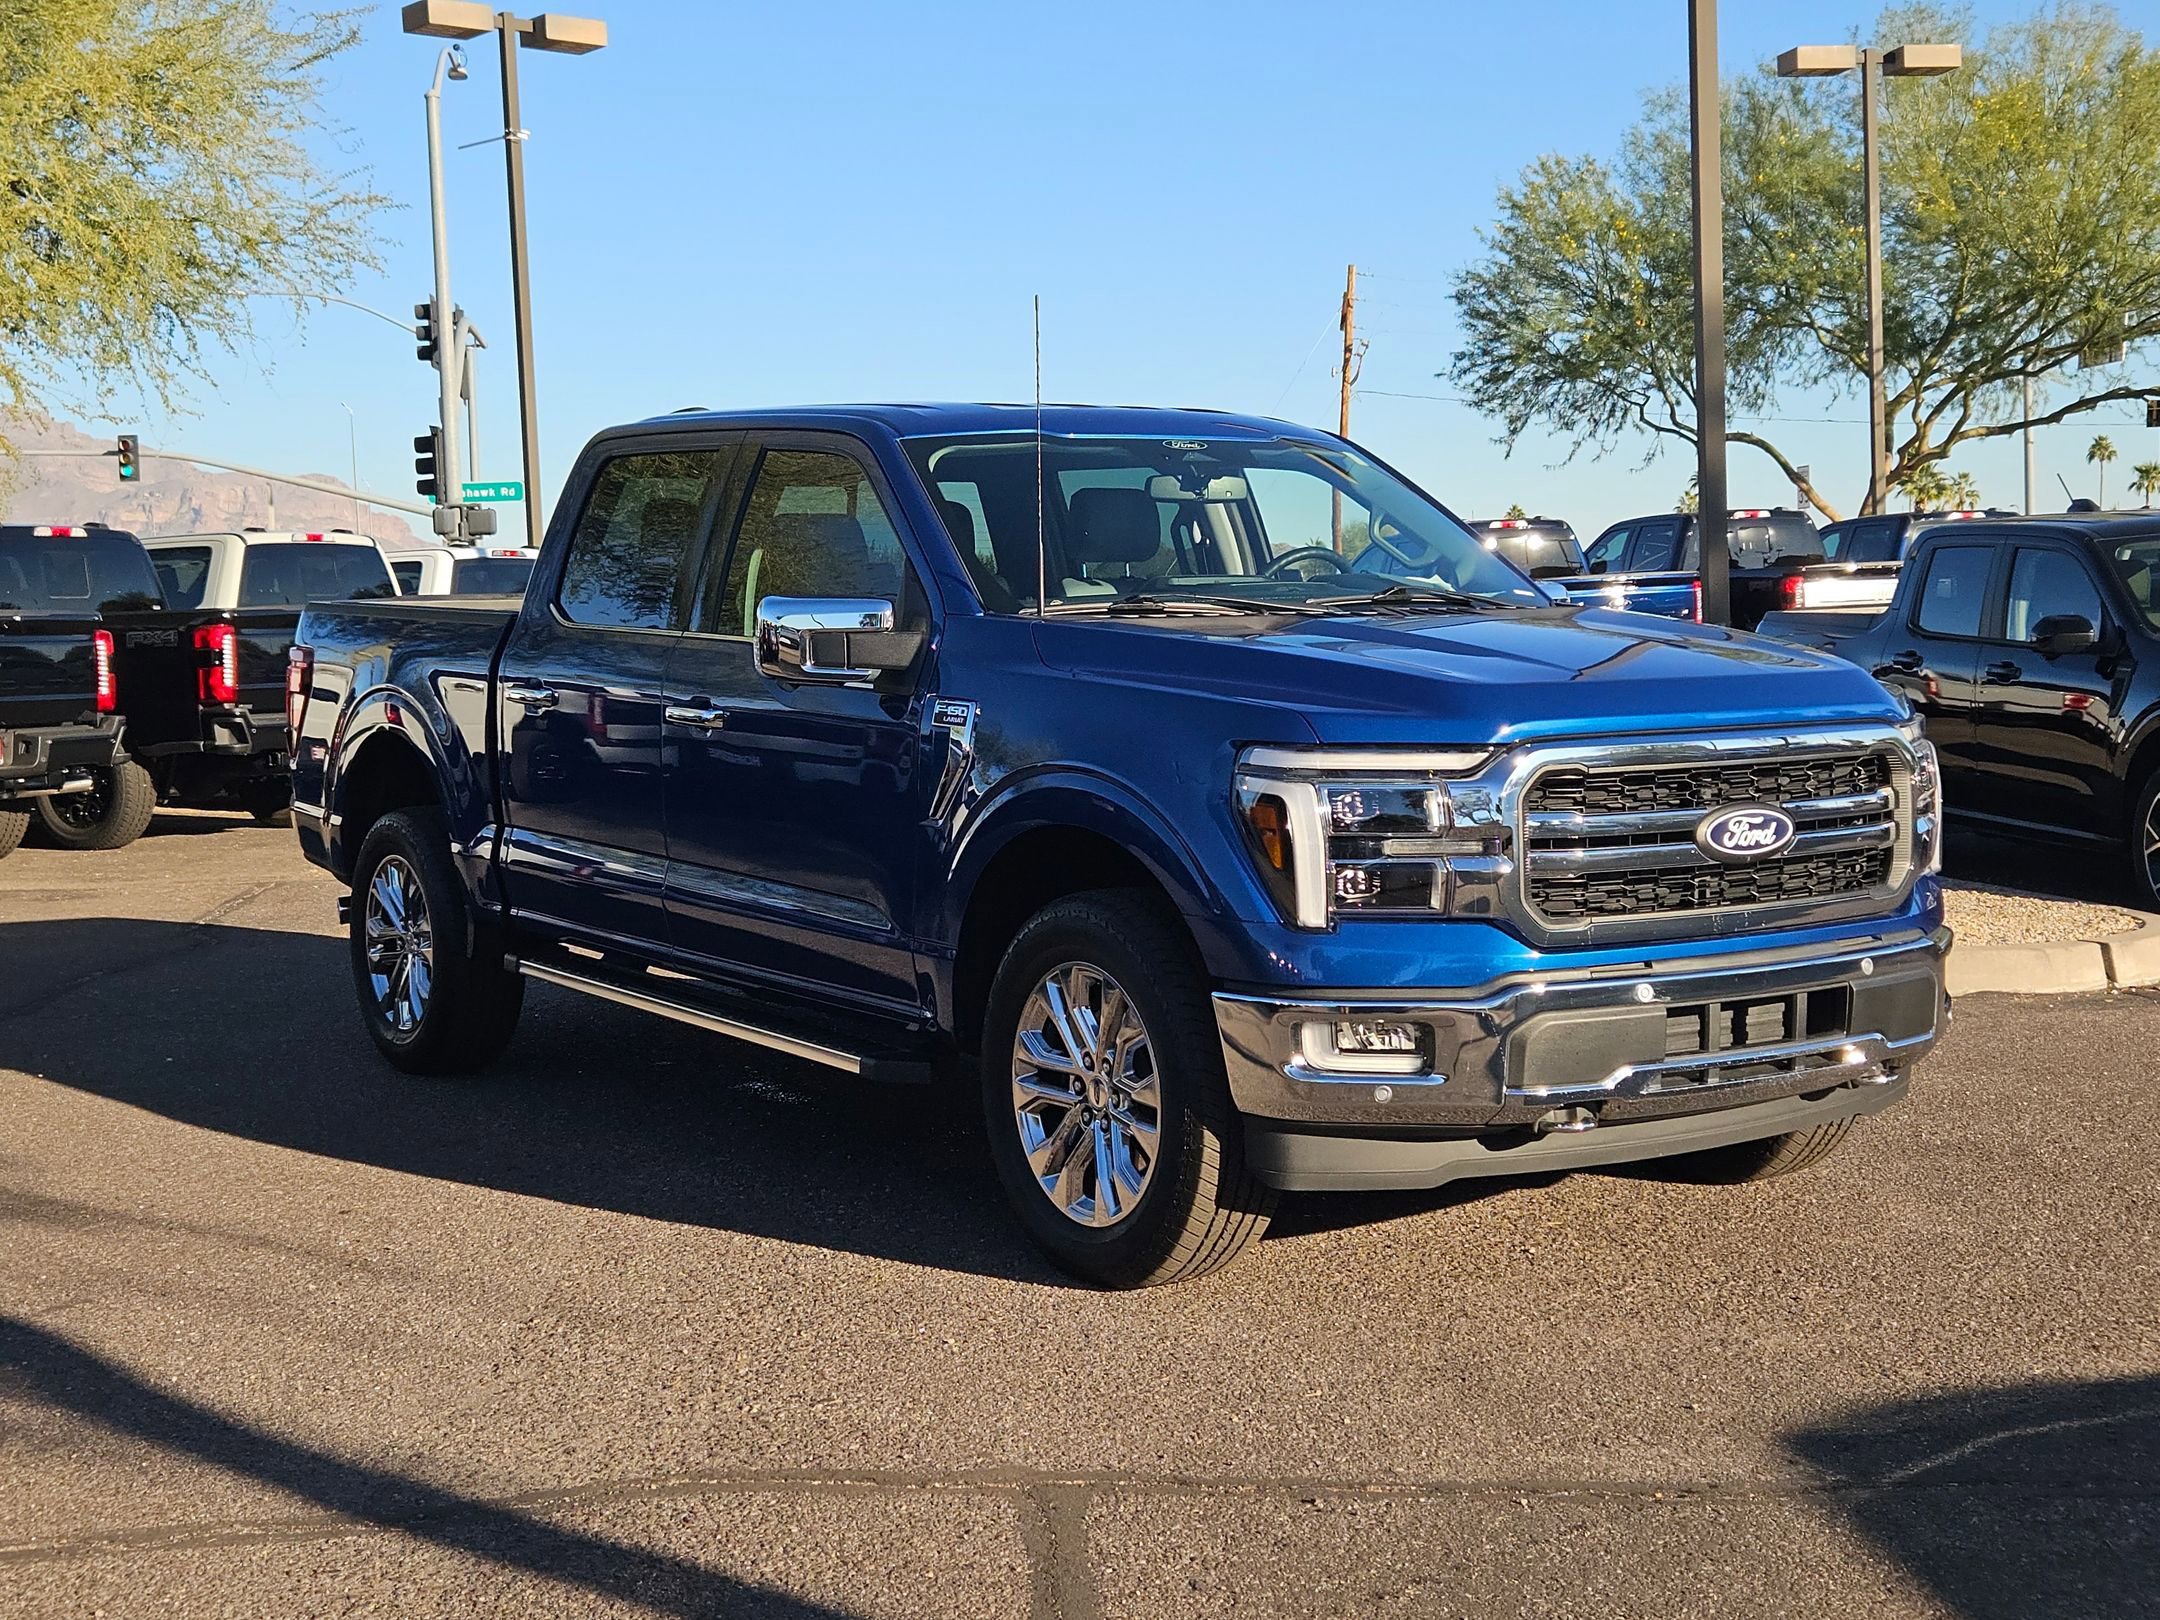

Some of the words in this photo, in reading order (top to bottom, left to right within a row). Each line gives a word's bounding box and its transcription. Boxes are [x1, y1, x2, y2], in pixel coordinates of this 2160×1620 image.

[1171, 440, 1201, 449] Ford
[500, 486, 516, 497] Rd
[126, 629, 178, 649] FX4
[935, 704, 968, 717] F-150
[943, 715, 965, 724] LARIAT
[1722, 816, 1777, 848] Ford
